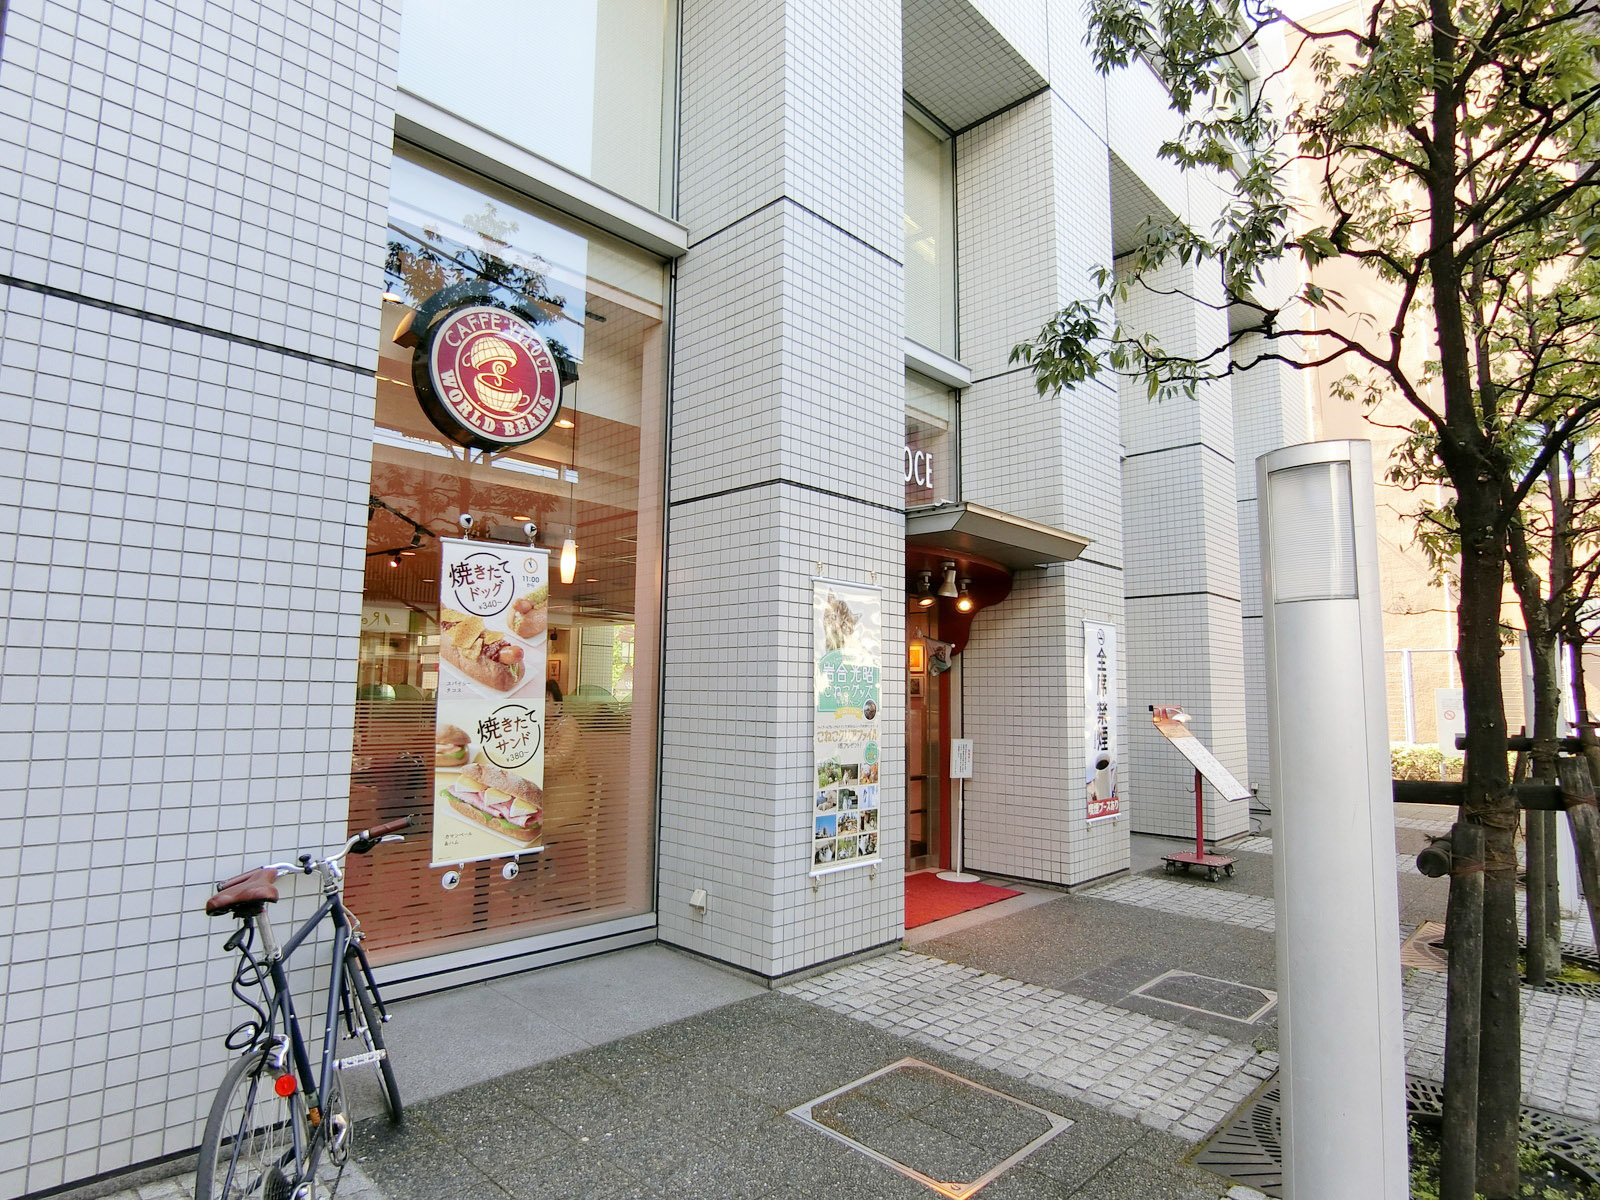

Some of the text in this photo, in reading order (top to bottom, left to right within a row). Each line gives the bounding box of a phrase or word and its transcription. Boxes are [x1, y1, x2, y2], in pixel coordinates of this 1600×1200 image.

[508, 320, 553, 374] VELOCE
[440, 369, 553, 436] WORLD BEANS
[449, 560, 512, 588] 焼きたて
[522, 575, 540, 583] 11:00
[470, 579, 505, 602] ドッグ
[477, 710, 538, 744] 焼きたて
[496, 731, 531, 755] サンド
